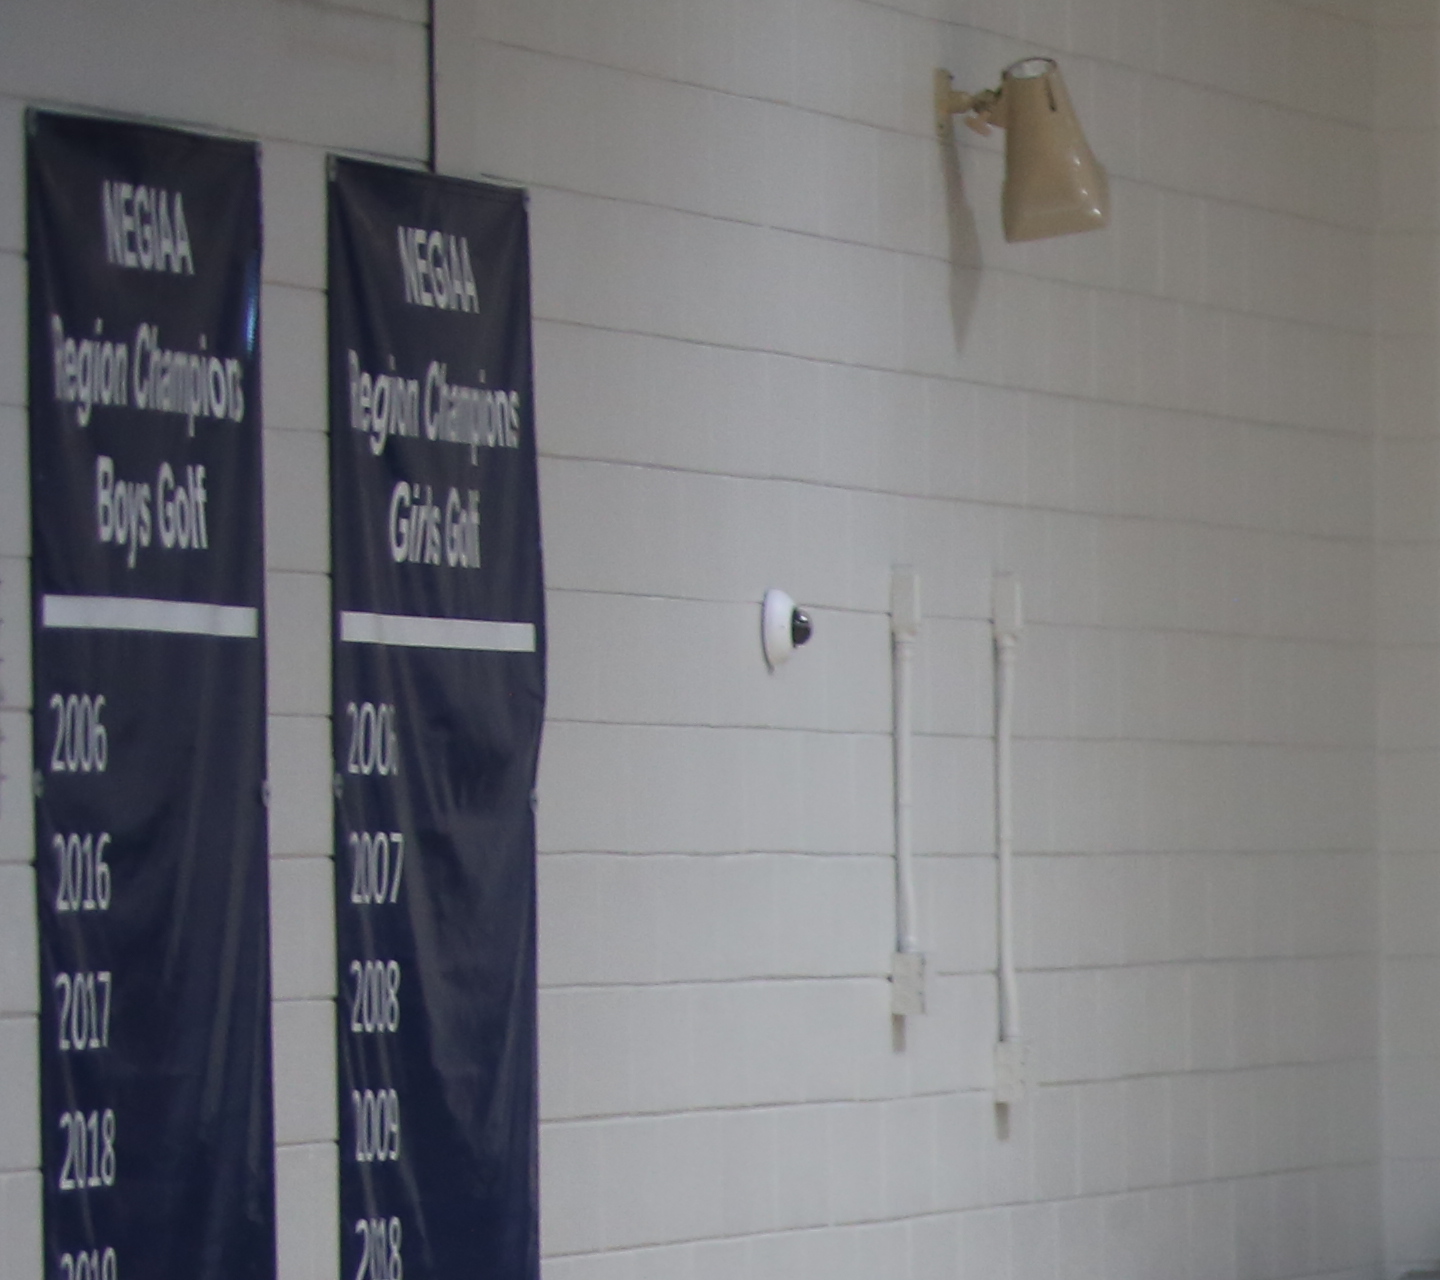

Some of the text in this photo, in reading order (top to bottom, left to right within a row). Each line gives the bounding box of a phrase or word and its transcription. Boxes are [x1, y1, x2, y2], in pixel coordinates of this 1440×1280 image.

[103, 179, 195, 275] NEGIAA
[397, 225, 480, 314] NEGIAA
[97, 454, 208, 569] Boys Golf
[389, 480, 442, 566] Girls
[50, 693, 107, 772] 2006
[53, 832, 112, 911] 2016
[350, 831, 403, 904] 2007
[55, 970, 112, 1050] 2017
[350, 960, 400, 1033] 2008
[59, 1108, 116, 1190] 2018
